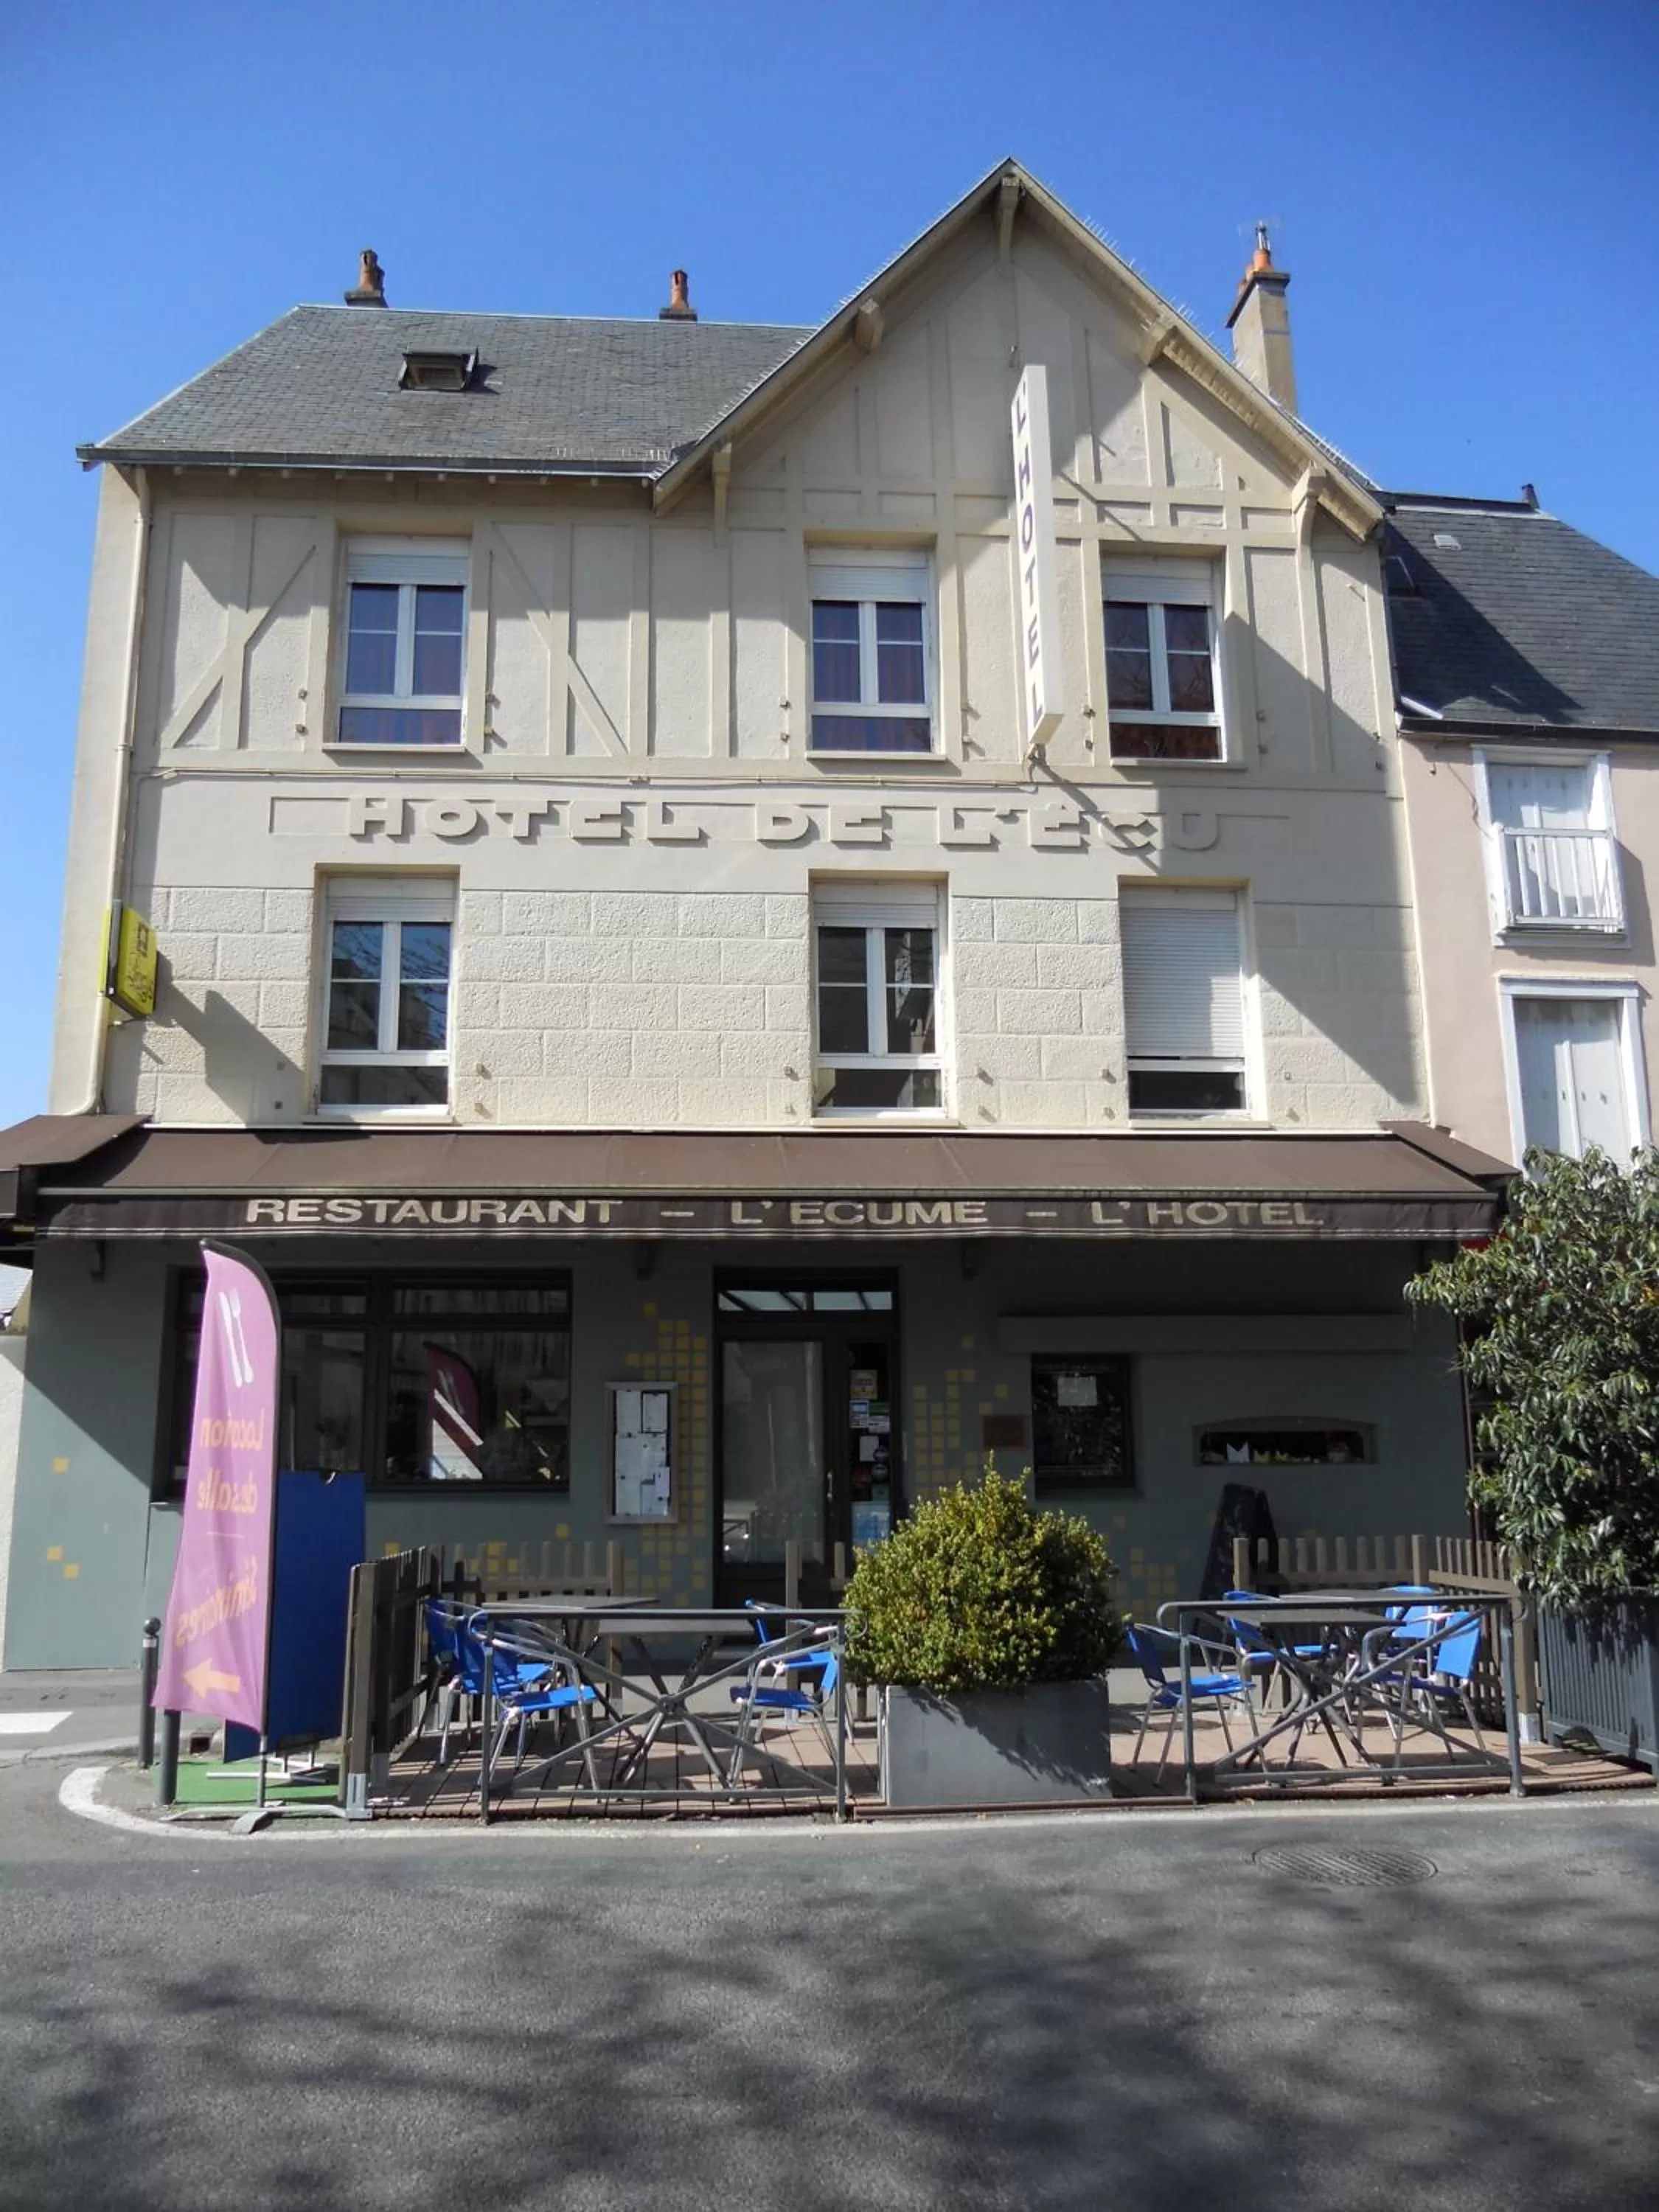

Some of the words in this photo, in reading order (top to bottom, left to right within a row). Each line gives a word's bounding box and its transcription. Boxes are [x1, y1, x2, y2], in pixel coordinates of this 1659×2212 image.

[349, 796, 700, 840] HOTEL
[756, 804, 883, 843] DE
[246, 1199, 623, 1223] RESTAURANT
